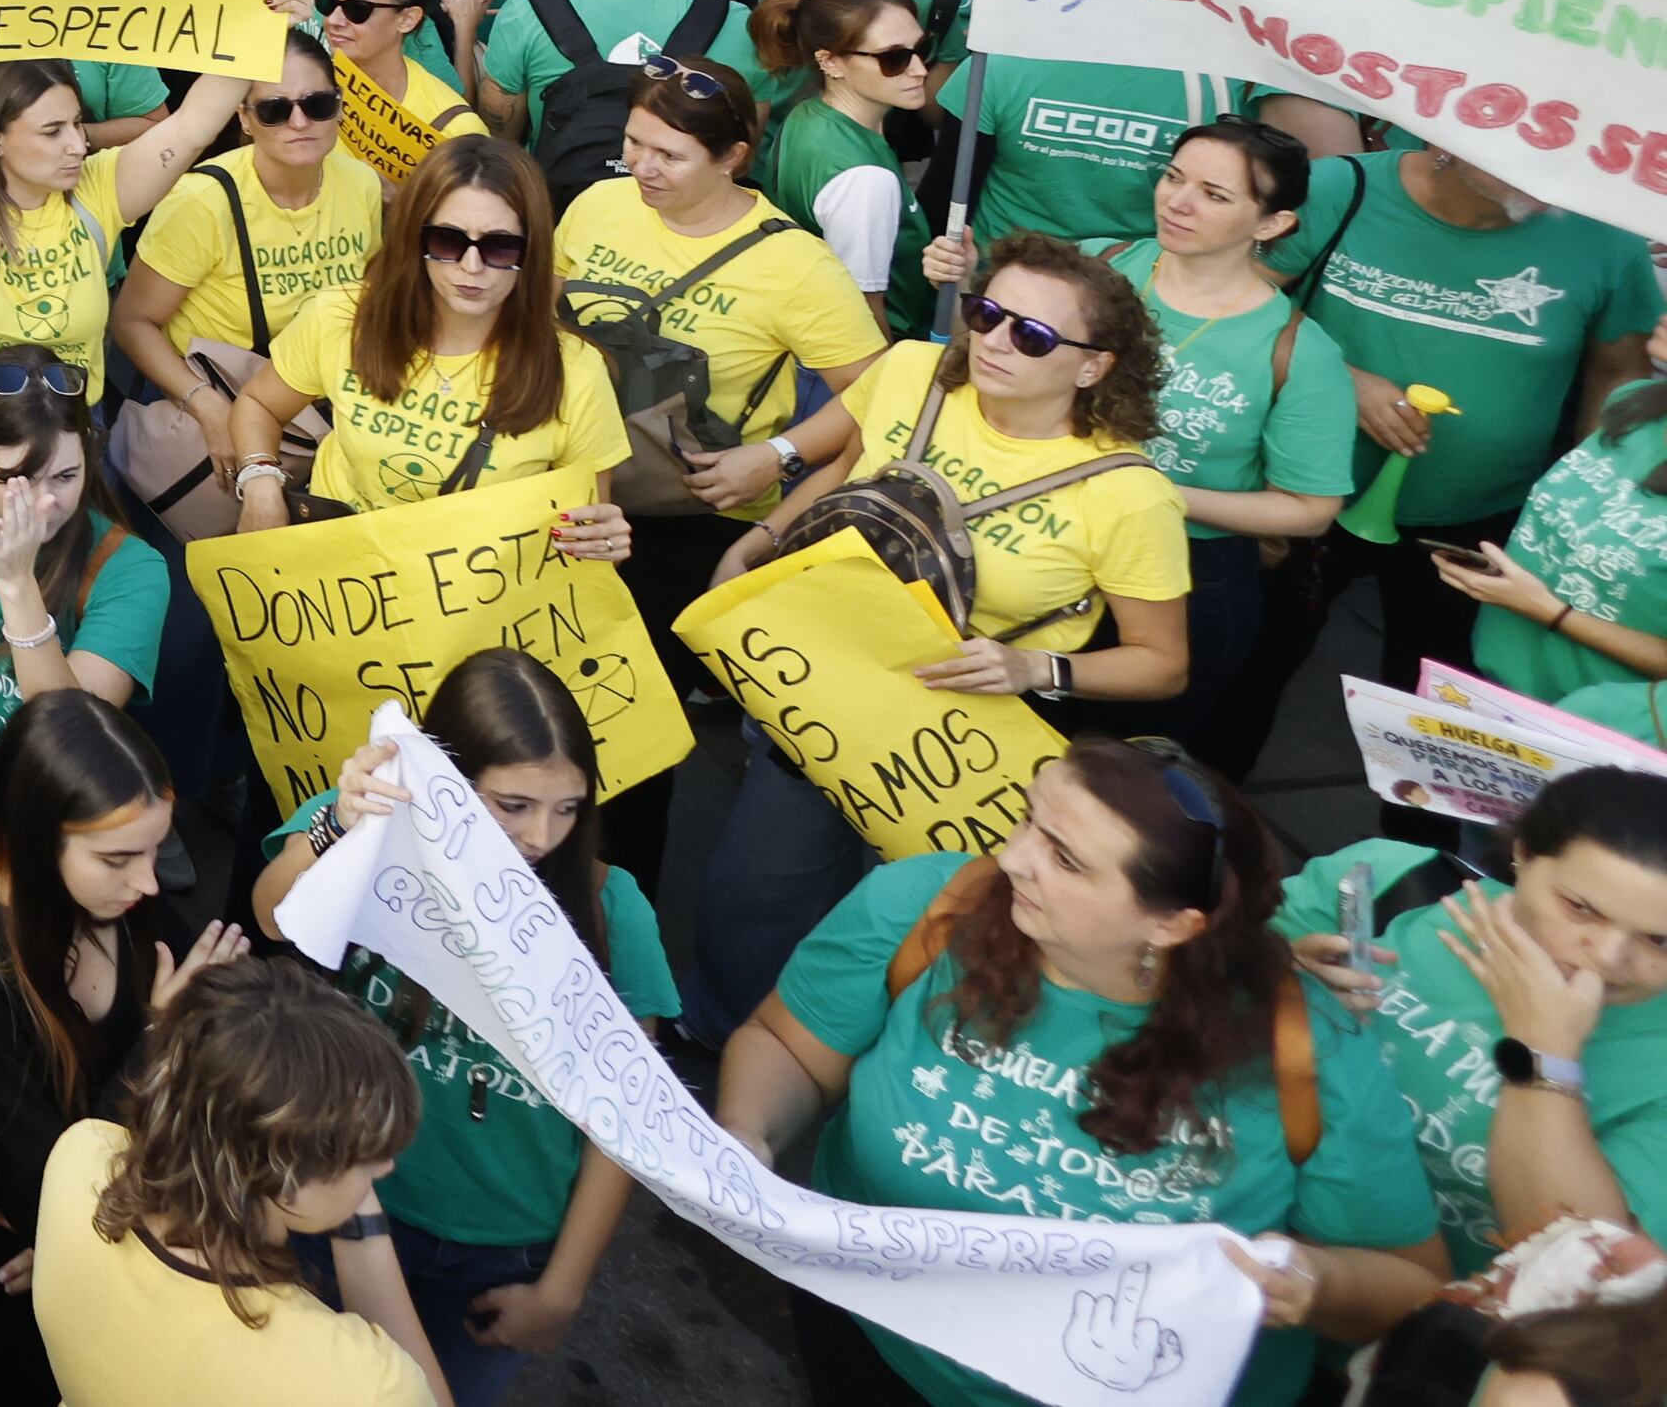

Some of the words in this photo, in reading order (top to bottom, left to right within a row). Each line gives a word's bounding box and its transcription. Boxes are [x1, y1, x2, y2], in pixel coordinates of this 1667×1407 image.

[1237, 5, 1582, 152] HOSTOS
[341, 100, 418, 167] CALIDAD
[1033, 106, 1160, 147] CCOO
[253, 226, 365, 269] DUCACIÓN
[260, 262, 365, 297] ESPECIAL
[253, 667, 327, 744] NO
[357, 659, 436, 723] SE
[1381, 729, 1504, 774] QUEREMOS
[1437, 720, 1523, 759] HUELGA
[1409, 750, 1479, 777] PARA
[1432, 768, 1450, 784] A
[1457, 774, 1503, 797] LOS
[472, 865, 557, 958] SE
[947, 1100, 1009, 1143] DE
[830, 1207, 1117, 1279] ESPERES
